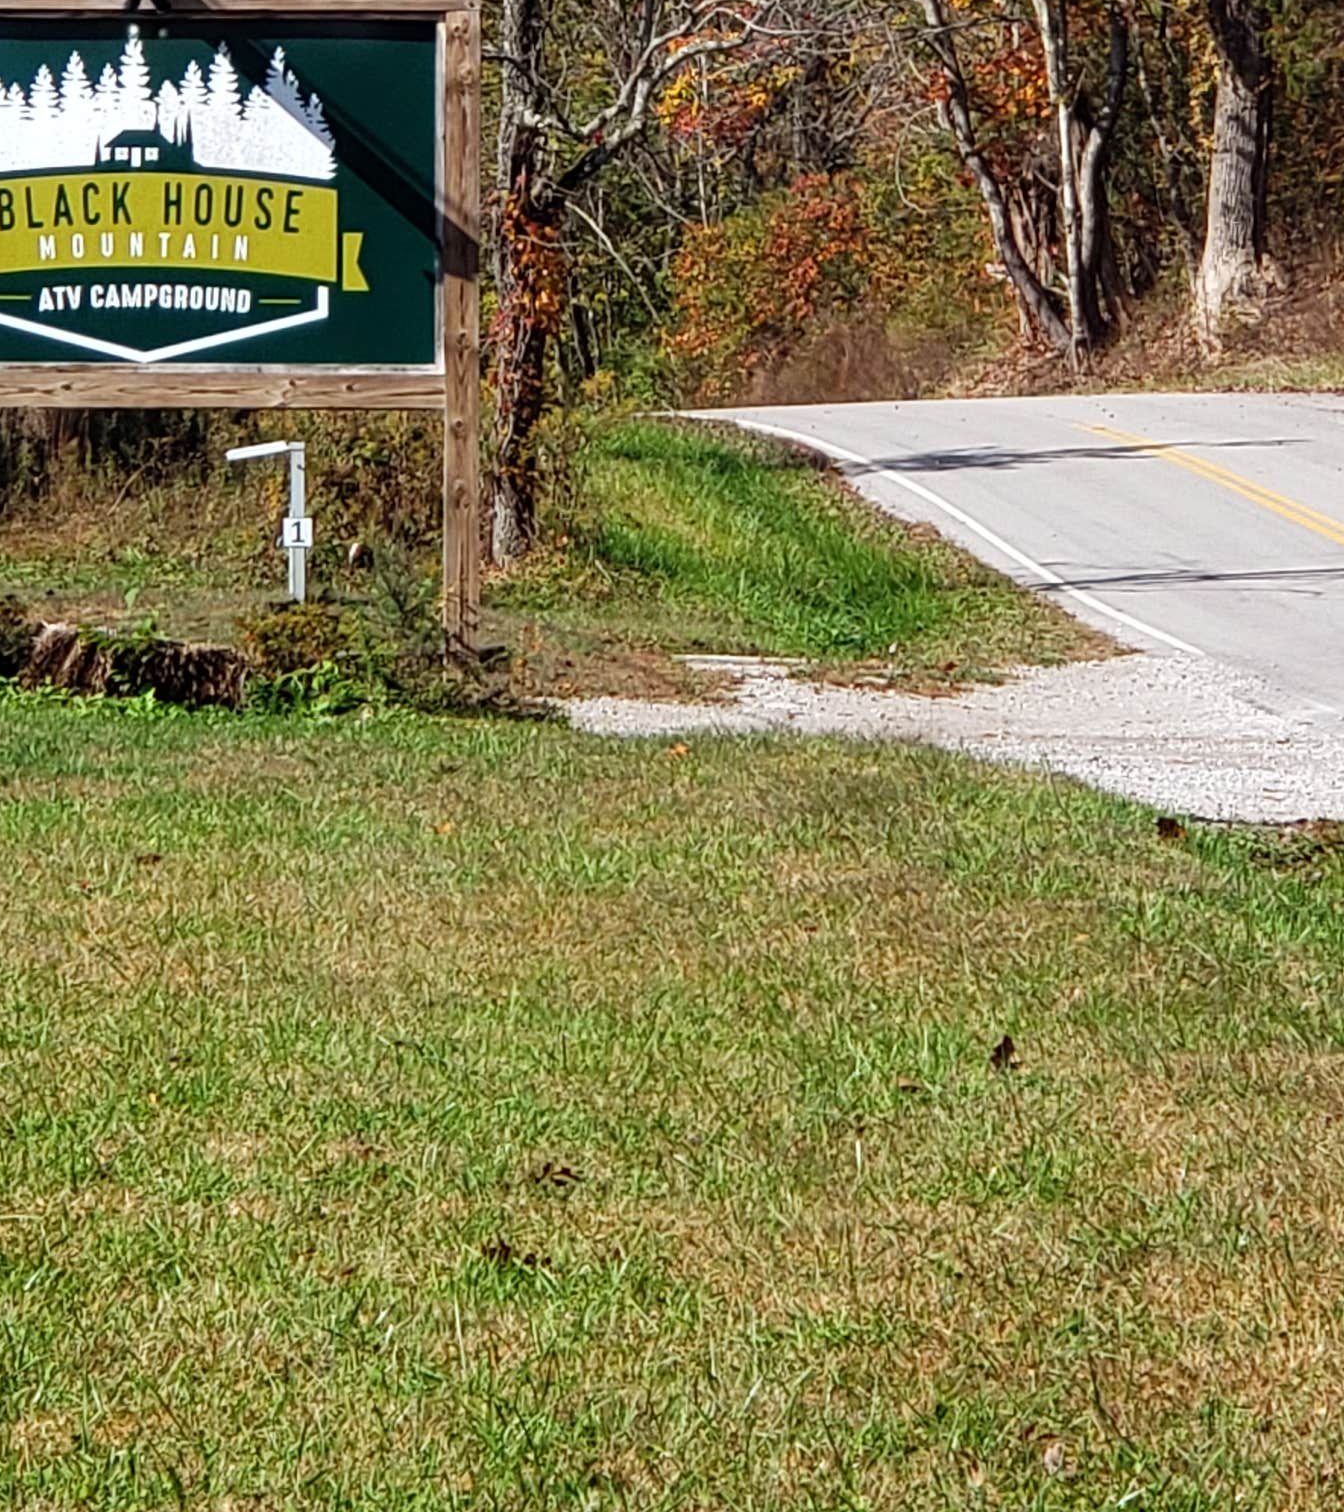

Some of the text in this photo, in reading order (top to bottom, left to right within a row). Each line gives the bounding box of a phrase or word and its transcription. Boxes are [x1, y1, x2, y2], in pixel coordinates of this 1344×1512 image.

[163, 181, 304, 233] HOUSE
[38, 231, 249, 262] MOUNTAIN
[38, 283, 252, 314] ATV CAMPGROUND
[290, 520, 305, 543] 1
